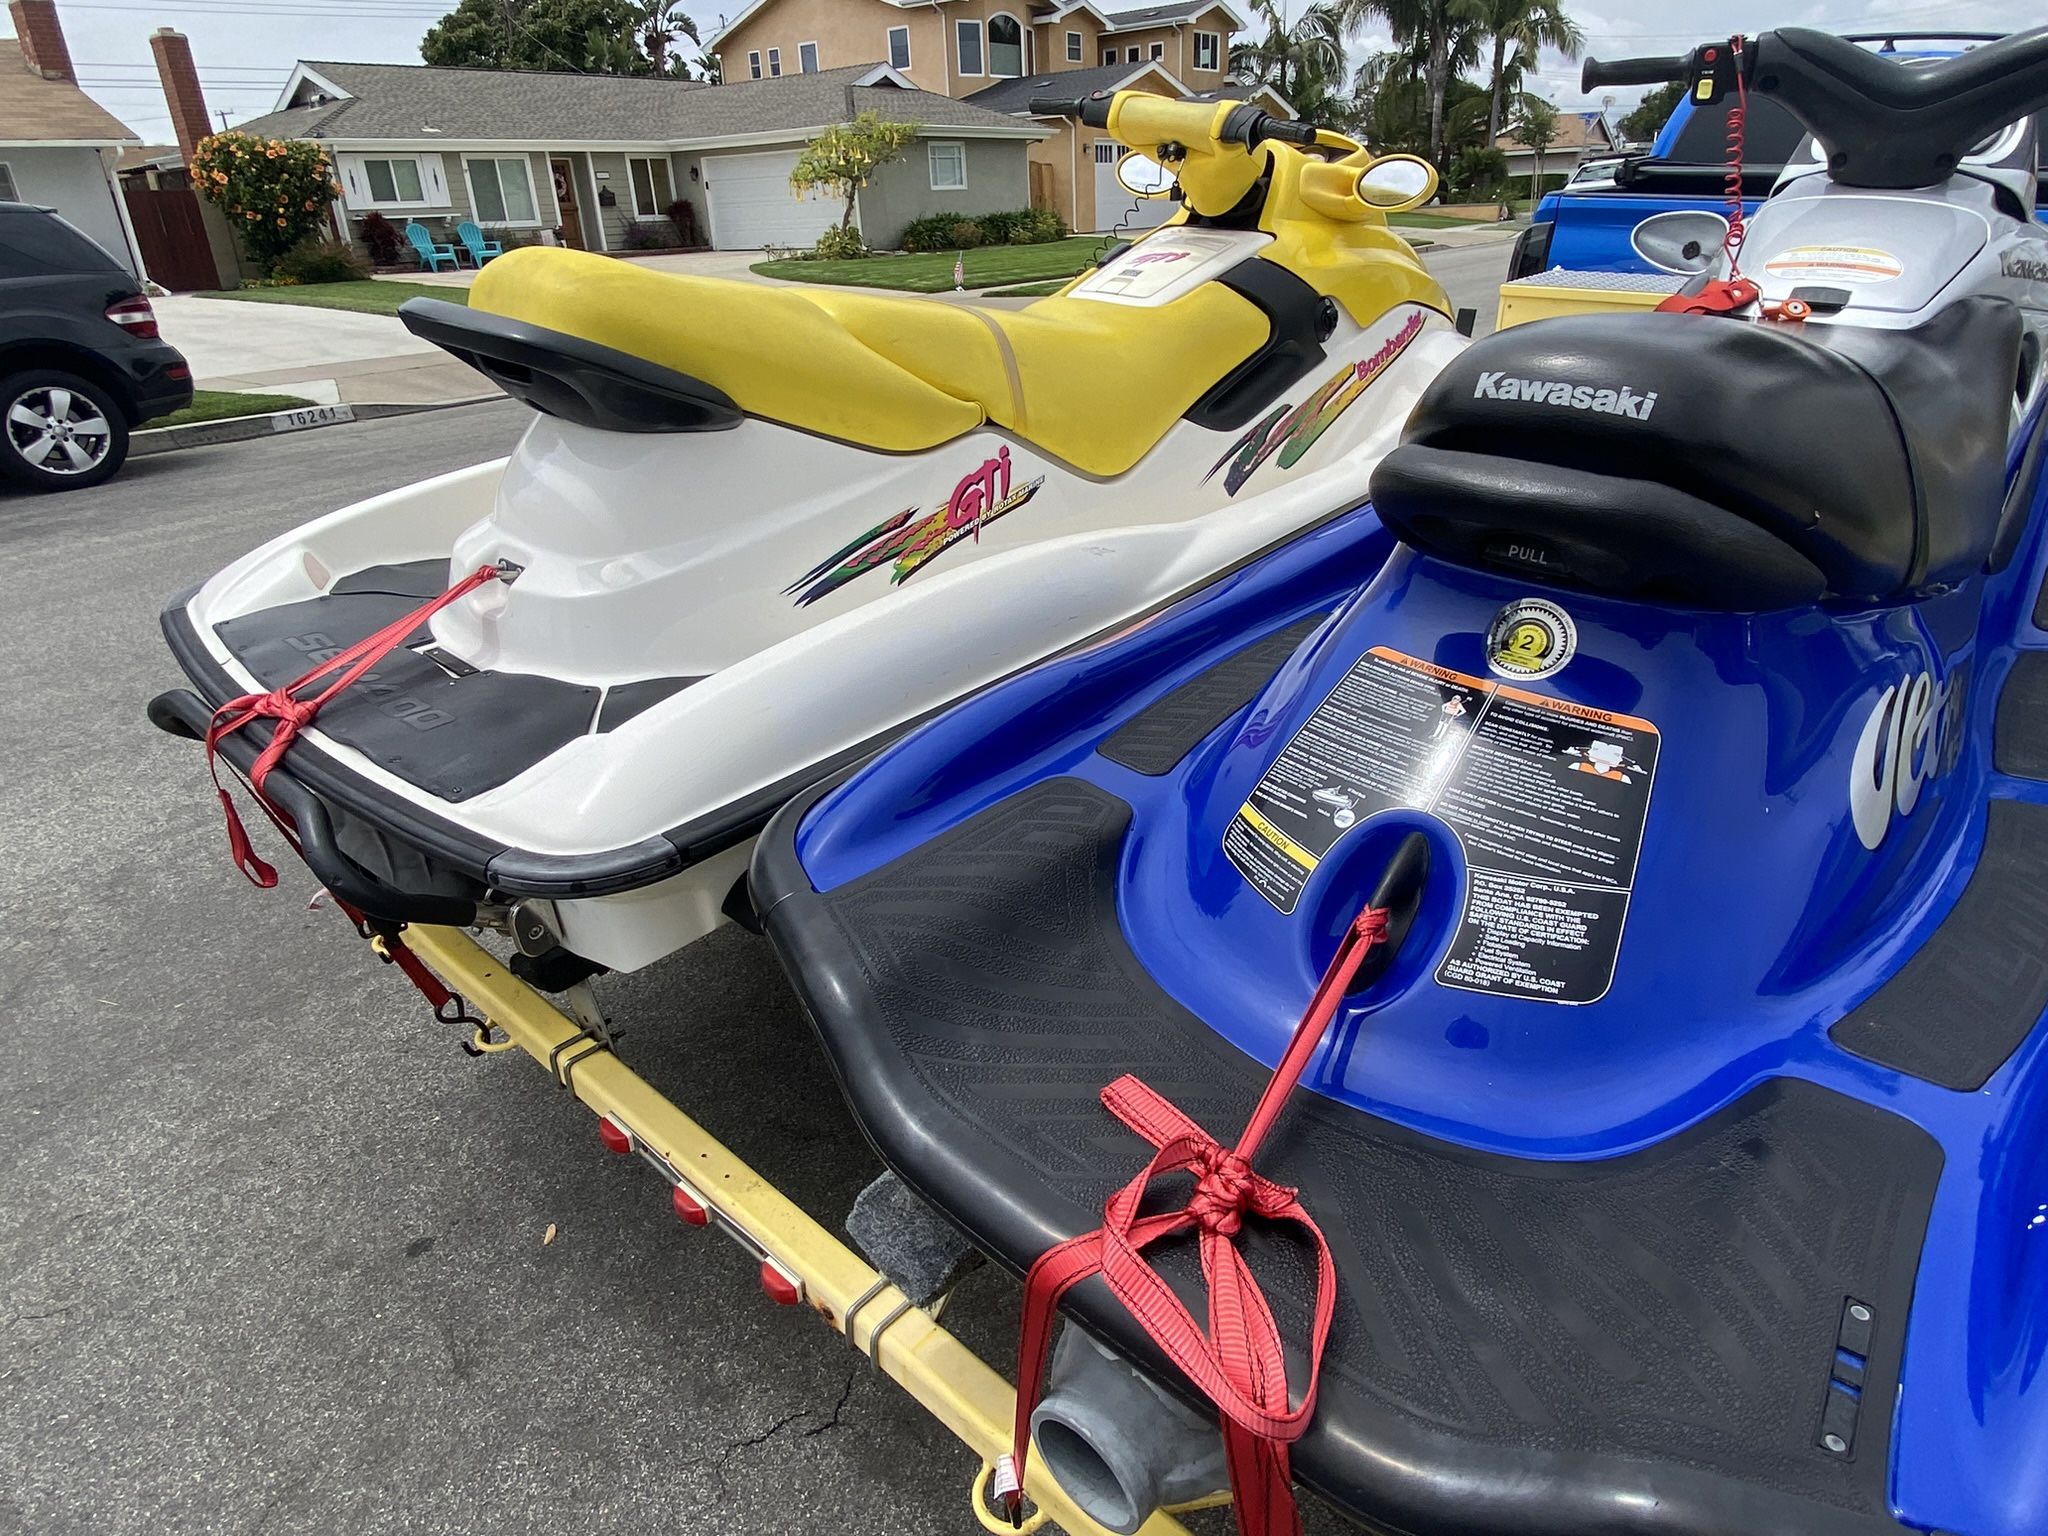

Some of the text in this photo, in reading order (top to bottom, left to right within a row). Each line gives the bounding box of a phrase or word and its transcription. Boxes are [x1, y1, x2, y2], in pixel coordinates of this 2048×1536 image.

[1356, 310, 1423, 381] Bombardier
[1474, 372, 1658, 420] Kawasaki
[288, 408, 336, 426] 16241
[947, 444, 1012, 544] GTi
[944, 474, 1046, 545] POWERED BY ROTAX MARINE
[1508, 545, 1548, 565] PULL
[1519, 635, 1535, 651] 2
[1408, 660, 1458, 681] WARNING
[1552, 699, 1613, 722] WARNING
[1257, 822, 1290, 850] CAUTION
[1473, 886, 1493, 895] Santa
[1514, 893, 1525, 901] CA
[1474, 873, 1508, 883] Kawasaki
[1508, 879, 1529, 887] Motor
[1554, 886, 1576, 895] U.S.A.
[1489, 882, 1503, 890] Box
[1470, 905, 1588, 932] FOLLOWING U.S. COAST GUARD
[1472, 899, 1581, 924] FROM COMPLIANCE WITH THE
[1473, 893, 1599, 920] THIS BOAT HAS BEEN EXEMPTED
[1468, 917, 1590, 946] ON THE DATE OF CERTIFICATION:
[1469, 911, 1498, 922] SAFETY
[1499, 916, 1544, 931] STANDARDS
[1556, 927, 1585, 938] EFFECT
[1482, 939, 1510, 951] Flotation
[1484, 933, 1526, 949] Safe Loading
[1486, 927, 1510, 938] Display
[1518, 933, 1546, 945] Capacity
[1546, 939, 1582, 952] Information
[1478, 951, 1530, 969] Electrical System
[1480, 945, 1518, 959] Fuel System
[1450, 958, 1566, 989] AS AUTHORIZED BY U.S. COAST
[1475, 958, 1536, 976] Powered Ventilation
[1448, 965, 1558, 994] GUARD GRANT OF EXEMPTION
